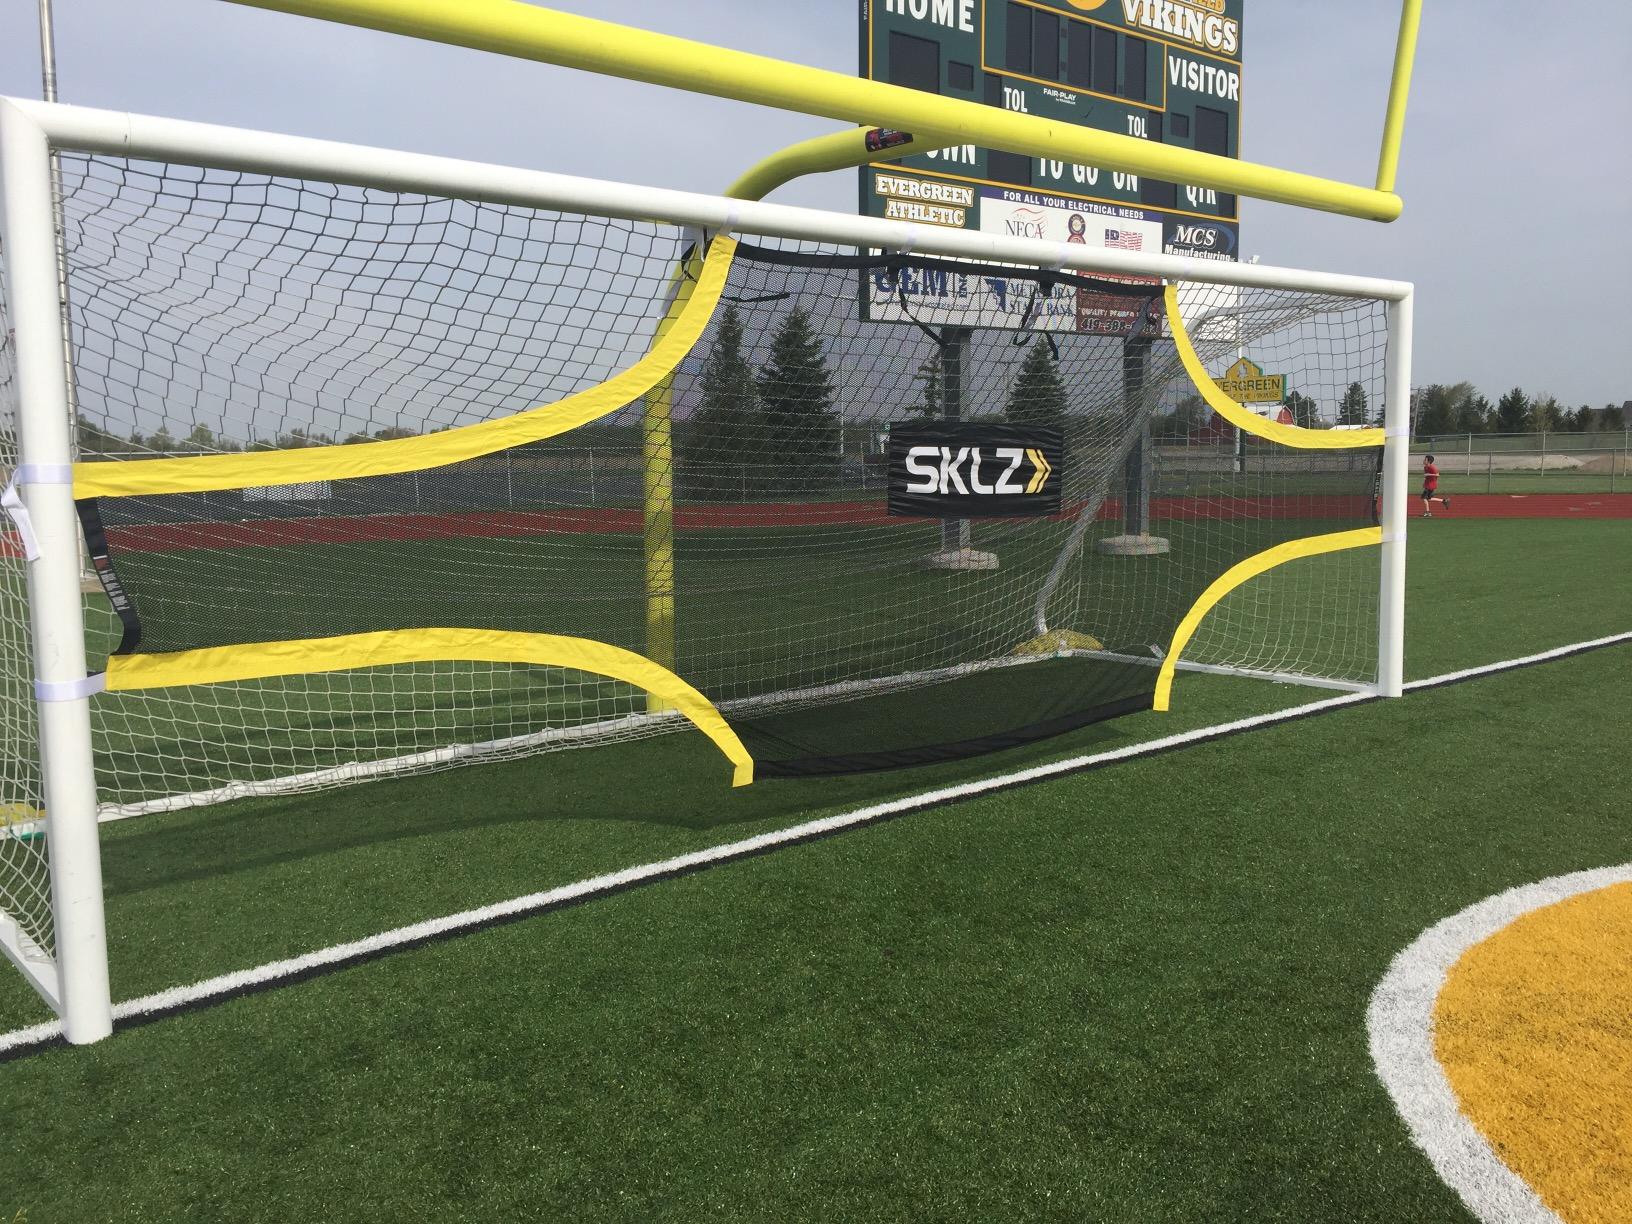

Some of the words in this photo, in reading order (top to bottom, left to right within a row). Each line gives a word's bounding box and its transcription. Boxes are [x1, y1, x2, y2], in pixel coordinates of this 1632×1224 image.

[1121, 0, 1238, 54] VIKINGS
[1168, 55, 1240, 102] VISITOR
[1004, 87, 1028, 113] TOL
[1043, 87, 1077, 101] FAIR-PLAY
[1127, 115, 1148, 138] TOL
[1072, 163, 1099, 186] GO
[1112, 171, 1138, 192] ON
[877, 175, 973, 206] EVERGREEN
[1185, 184, 1217, 207] QTR
[886, 201, 966, 226] ATHLETIC
[1003, 190, 1021, 202] FOR
[1024, 192, 1040, 205] ALL
[1042, 196, 1066, 209] YOUR
[1068, 200, 1117, 216] ELECTRICAL
[1119, 208, 1145, 220] NEEDS
[1174, 225, 1217, 247] MCS
[1164, 244, 1231, 262] Manufacturing
[905, 446, 1024, 495] SKLZ
